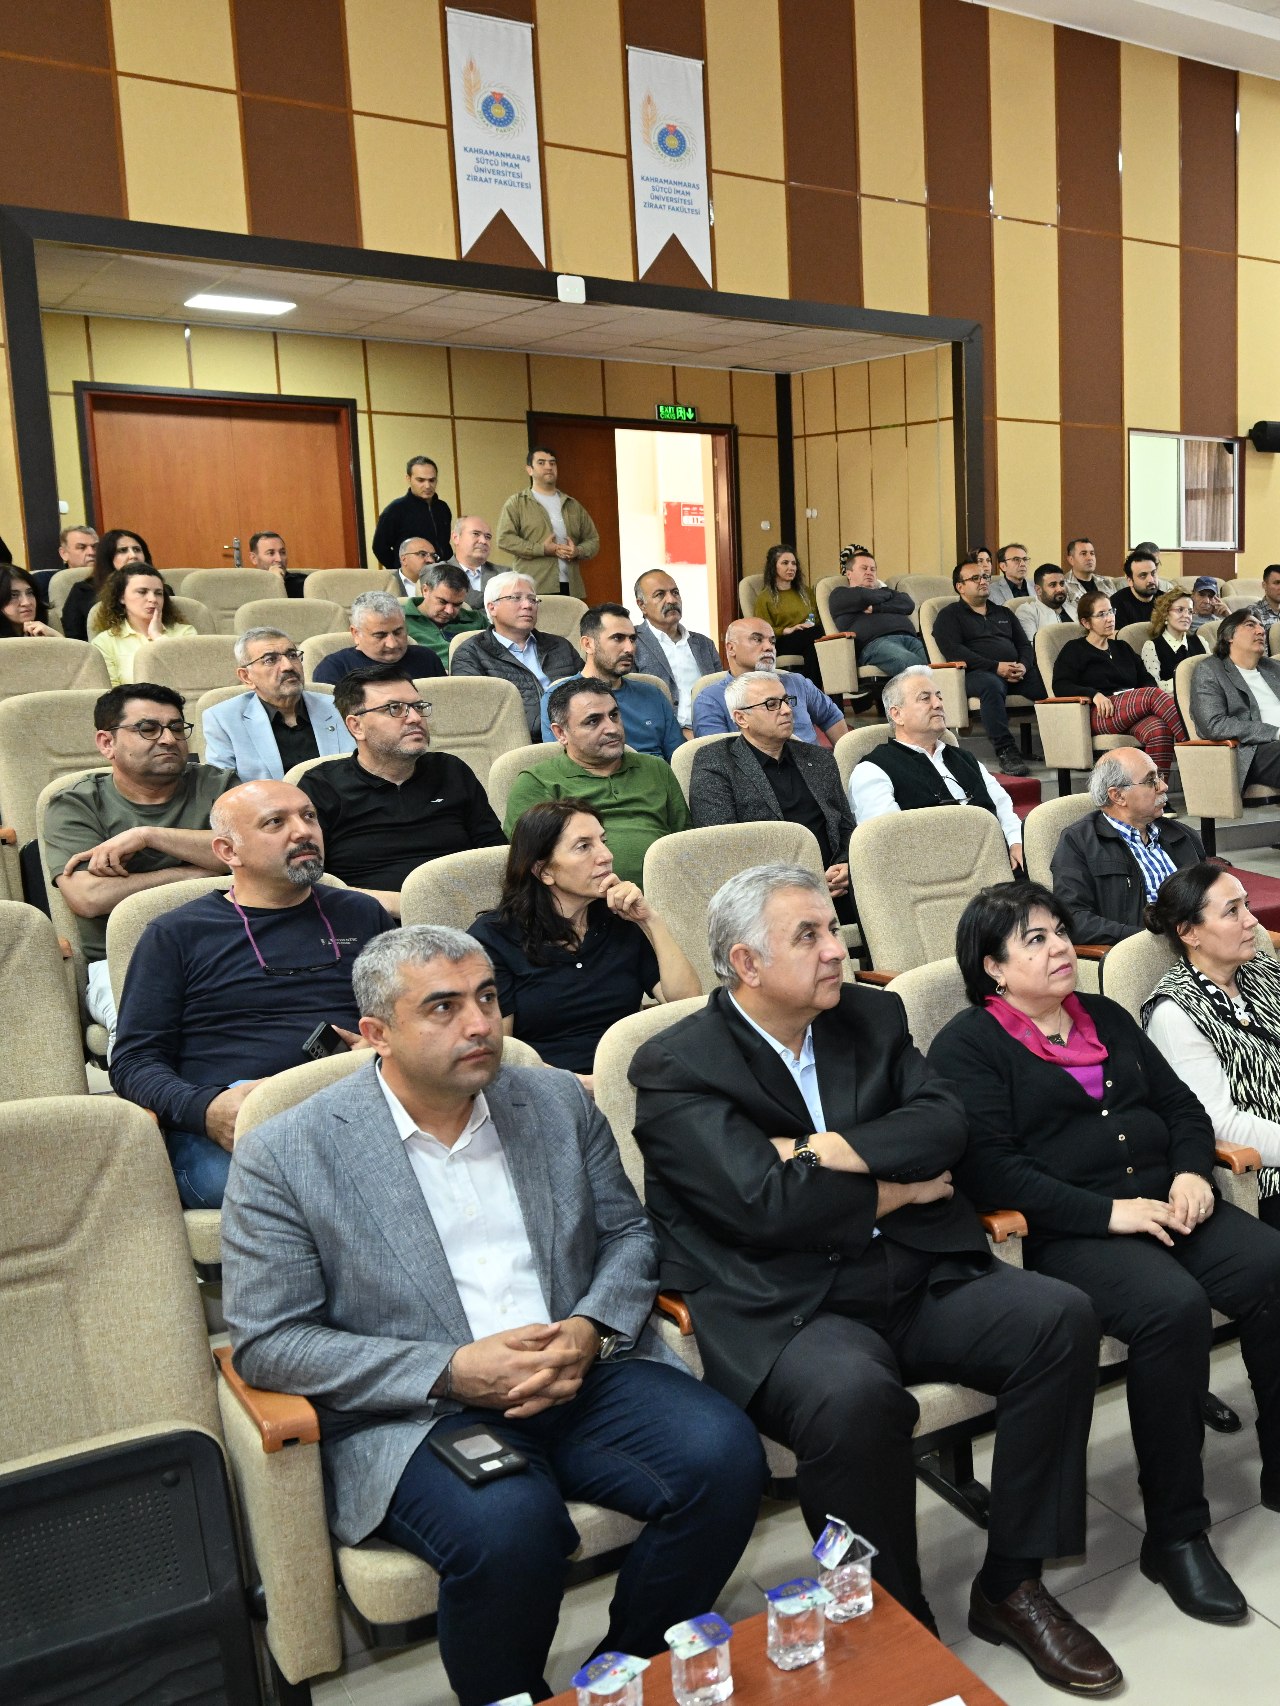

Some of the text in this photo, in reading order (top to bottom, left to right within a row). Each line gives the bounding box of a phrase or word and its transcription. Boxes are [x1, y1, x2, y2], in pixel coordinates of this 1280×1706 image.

[463, 146, 531, 163] KAHRAMANMARAŞ
[475, 156, 520, 170] SÜTÇÜ İMAM
[473, 164, 523, 179] ÜNİVERSİTESİ
[466, 173, 532, 190] ZİRAAT FAKÜLTESİ
[640, 175, 701, 191] KAHRAMANMARAŞ
[651, 185, 691, 197] SÜTÇÜ İMAM
[650, 192, 694, 206] ÜNİVERSİTESİ
[643, 201, 701, 216] ZİRAAT FAKÜLTESİ
[659, 405, 675, 413] EXIT
